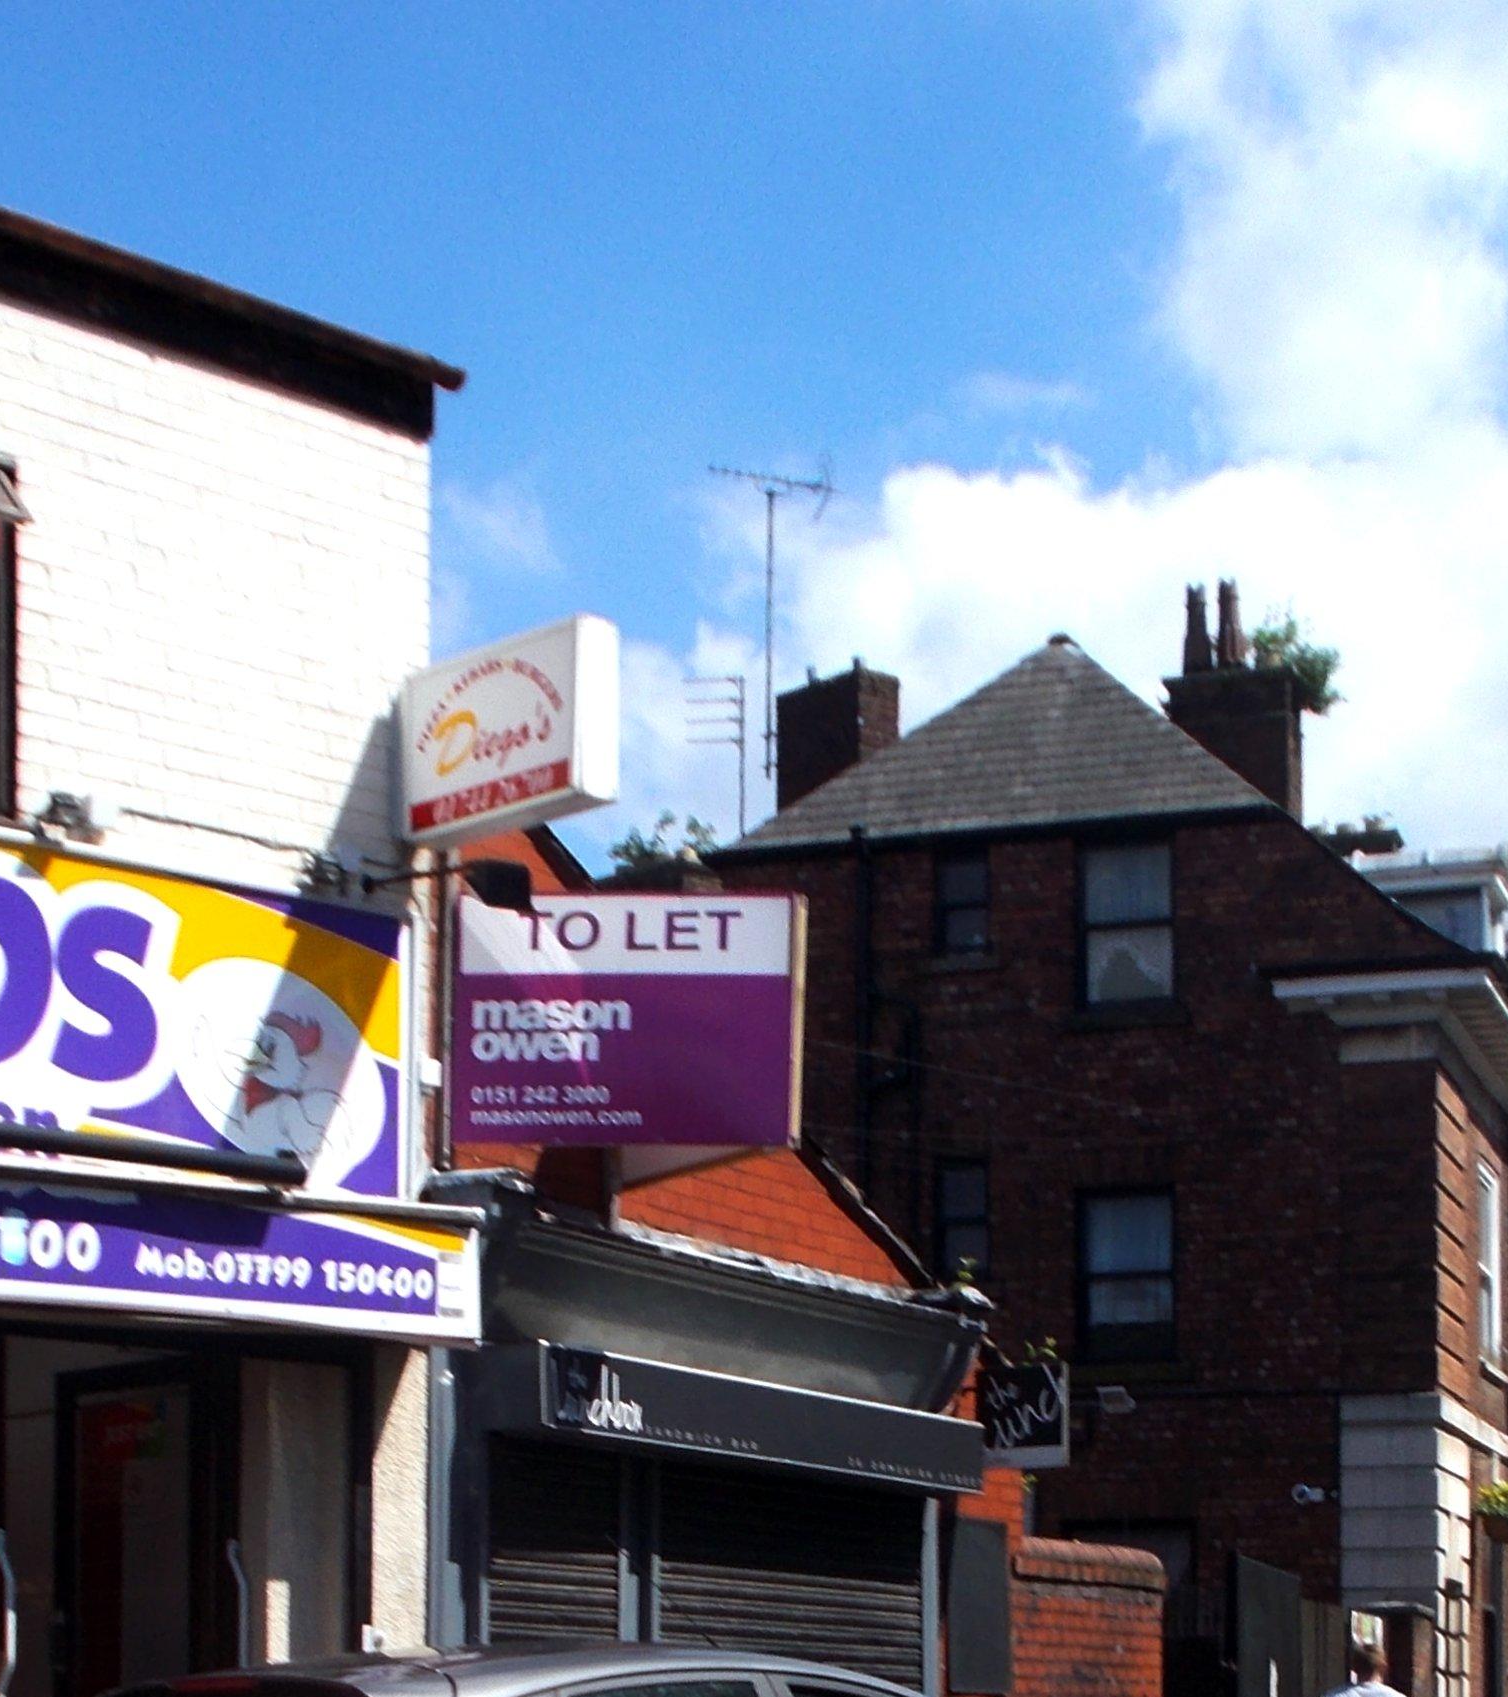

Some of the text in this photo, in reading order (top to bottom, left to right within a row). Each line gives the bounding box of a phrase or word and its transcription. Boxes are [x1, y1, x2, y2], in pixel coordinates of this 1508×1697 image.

[432, 700, 552, 777] Diego's
[526, 910, 744, 951] TO LET
[471, 999, 633, 1031] mason
[470, 1030, 601, 1062] owen
[471, 1085, 517, 1105] 0151
[522, 1085, 558, 1105] 242
[470, 1109, 643, 1127] masonowen.com
